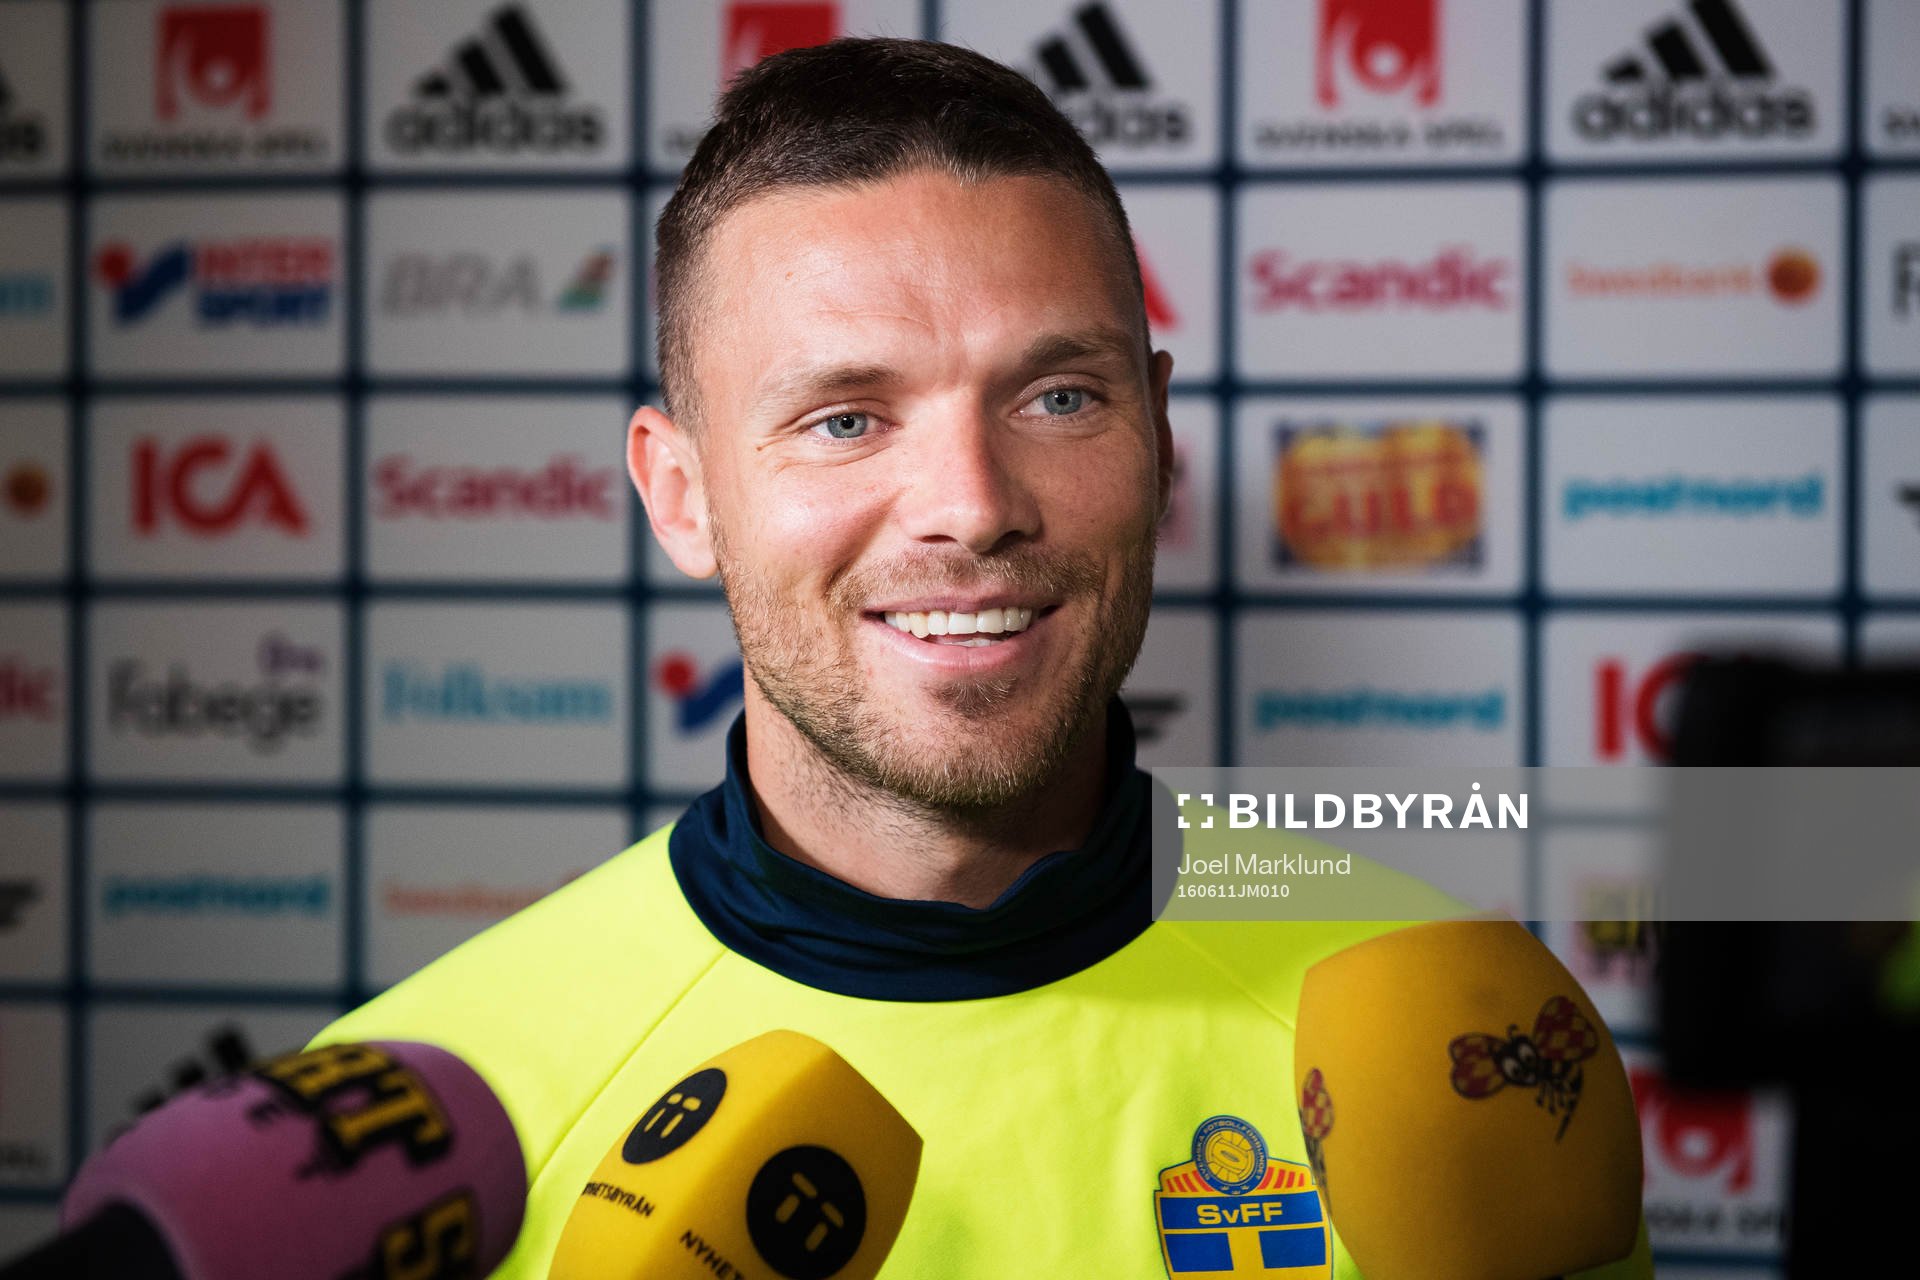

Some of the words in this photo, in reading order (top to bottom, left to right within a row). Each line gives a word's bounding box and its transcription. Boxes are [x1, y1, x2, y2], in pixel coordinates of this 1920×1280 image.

[386, 100, 603, 153] adidas
[1573, 84, 1815, 139] adidas
[1249, 247, 1509, 310] Scandic
[130, 435, 311, 538] ICA
[374, 456, 616, 521] Scandic
[1196, 1201, 1283, 1225] SvFF
